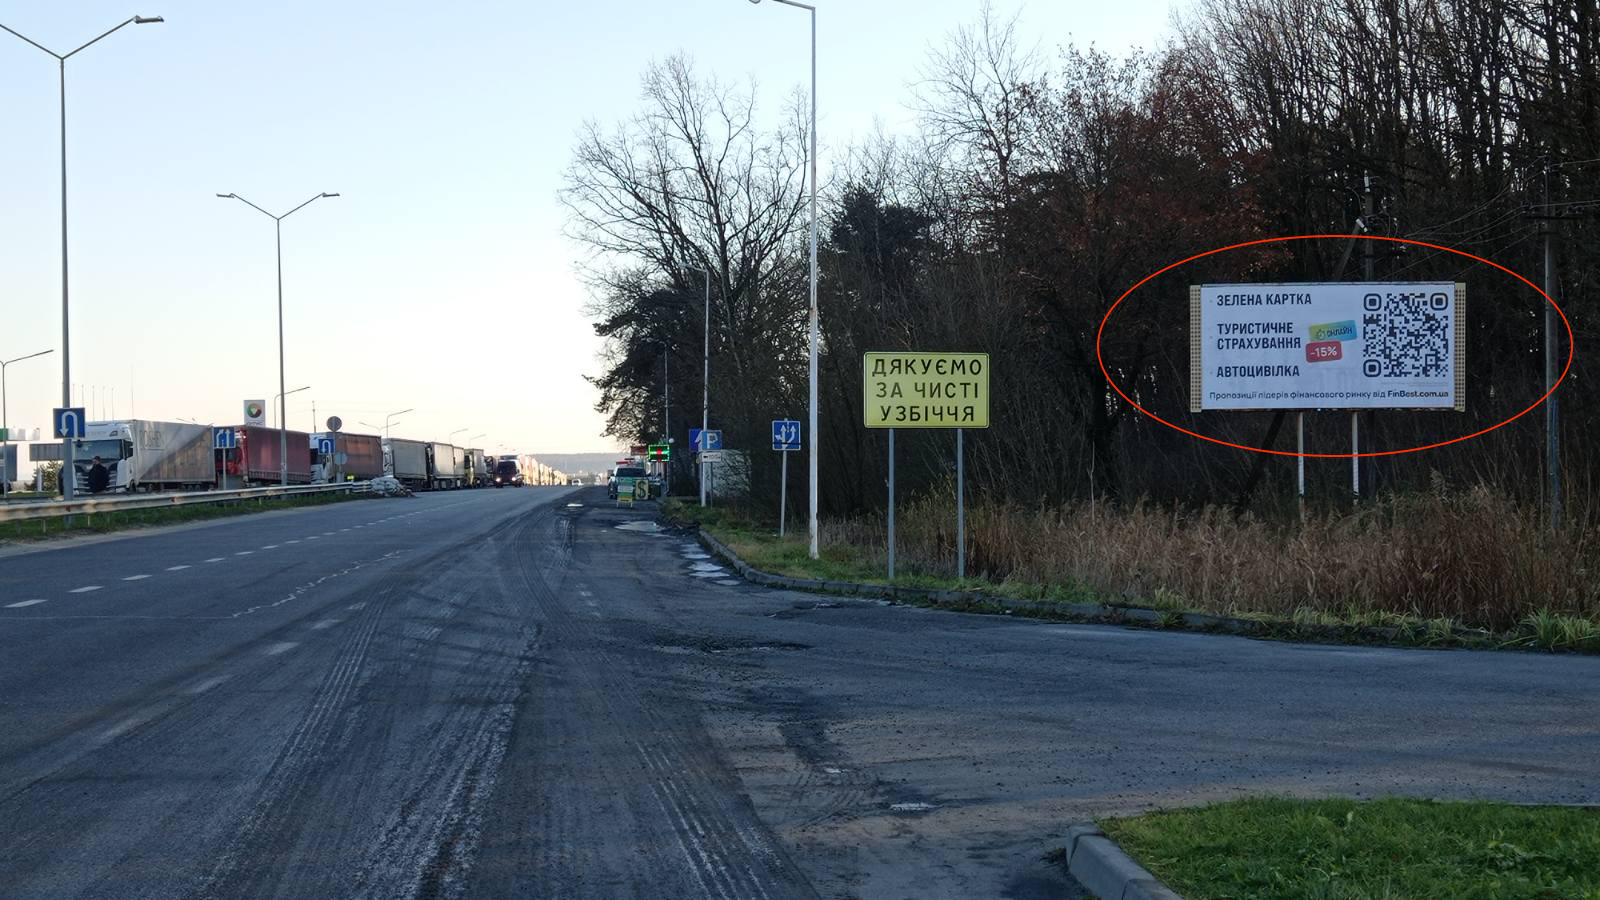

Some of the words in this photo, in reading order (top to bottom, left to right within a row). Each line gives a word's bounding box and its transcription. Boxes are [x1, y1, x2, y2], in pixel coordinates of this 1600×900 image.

[1216, 294, 1263, 306] ЗЕЛЕНА
[1266, 293, 1312, 305] КАРТКА
[1217, 322, 1293, 335] ТУРИСТИЧНЕ
[1327, 326, 1353, 338] ОНЛАЙН
[1217, 337, 1301, 350] СТРАХУВАННЯ
[1310, 346, 1338, 358] -15%
[872, 359, 982, 377] ДЯКУЄМО
[1216, 365, 1300, 379] АВТОЦИВІЛКА
[876, 382, 903, 398] ЗА
[914, 382, 978, 398] ЧИСТІ
[1209, 391, 1257, 401] Пропозиції
[1258, 391, 1289, 401] лідерів
[1290, 391, 1344, 401] фінансового
[1346, 391, 1372, 400] ринку
[1373, 390, 1386, 399] від
[1387, 390, 1449, 398] FinBest.com.ua
[880, 405, 974, 422] УЗБІЧЧЯ
[637, 480, 646, 498] $
